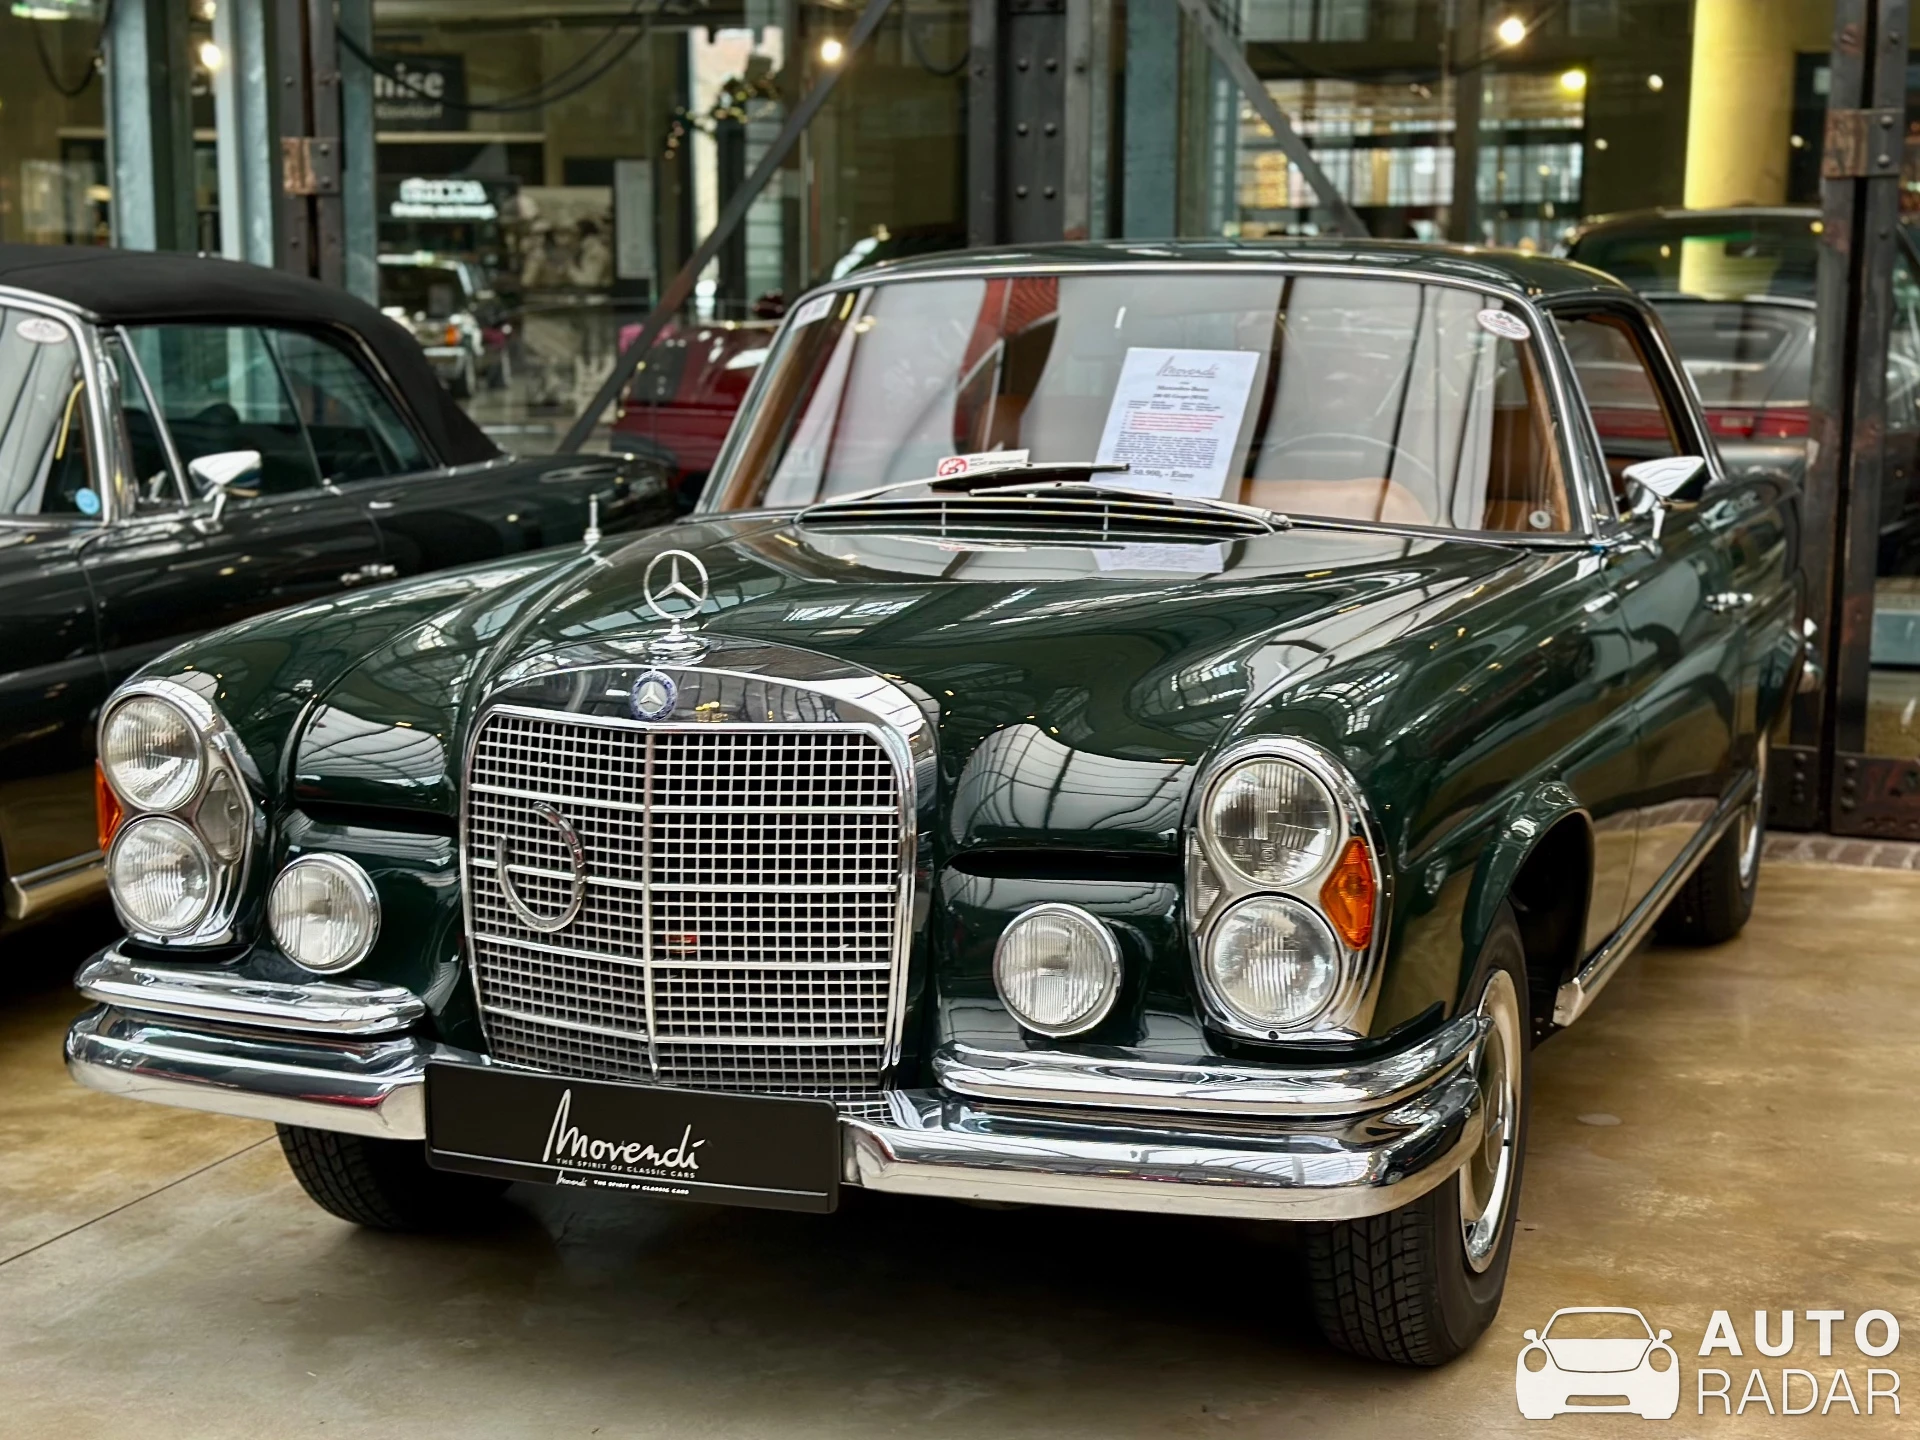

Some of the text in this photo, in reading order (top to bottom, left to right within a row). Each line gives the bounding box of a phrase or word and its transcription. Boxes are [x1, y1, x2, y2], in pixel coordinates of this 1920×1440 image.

[542, 1088, 706, 1170] Movendi
[556, 1158, 574, 1166] THE
[577, 1160, 607, 1169] SPIRIT
[626, 1166, 667, 1176] CLASSIC
[670, 1170, 696, 1179] CARS
[641, 1185, 670, 1193] CLASSIC
